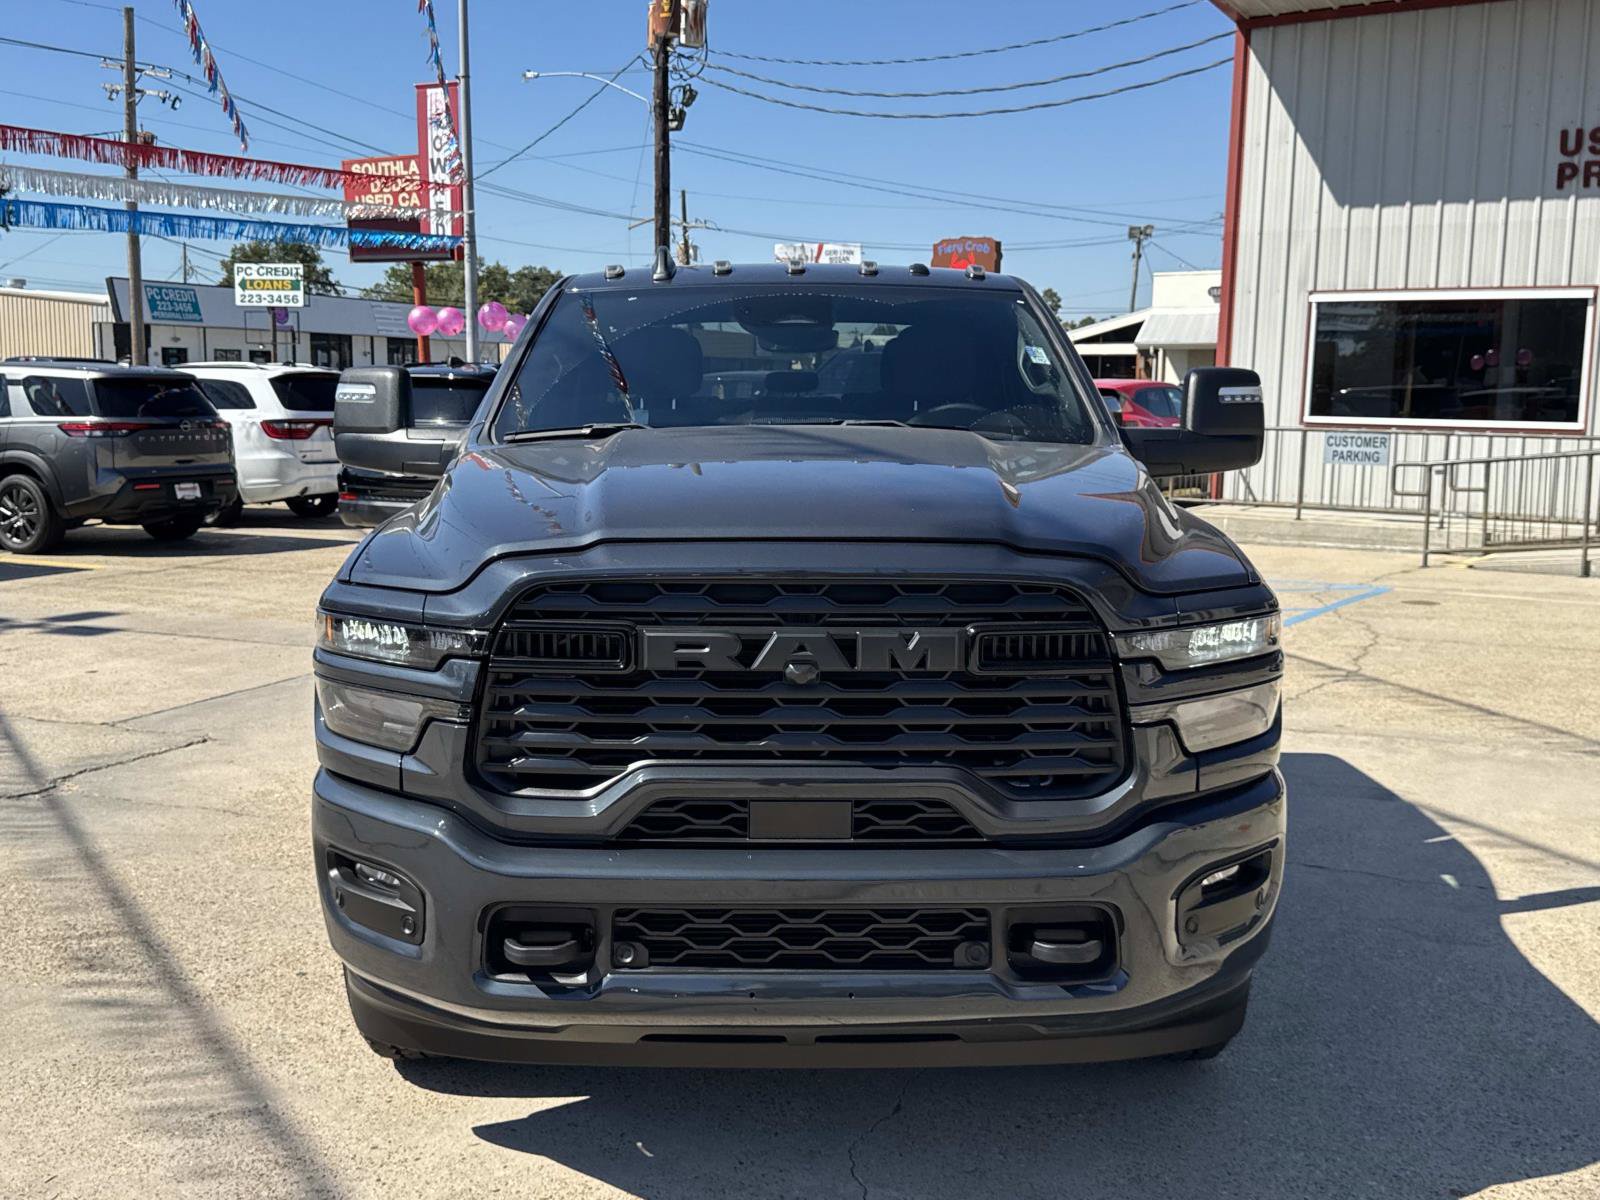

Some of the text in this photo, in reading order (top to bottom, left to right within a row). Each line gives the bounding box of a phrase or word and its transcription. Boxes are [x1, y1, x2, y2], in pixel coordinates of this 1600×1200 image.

[1556, 161, 1600, 190] PR
[236, 266, 301, 276] PC CREDIT
[246, 280, 292, 290] LOANS
[146, 288, 196, 303] PC CREDIT
[240, 294, 299, 304] 223-3456
[1326, 435, 1388, 449] CUSTOMER
[1332, 450, 1380, 463] PARKING
[643, 631, 958, 671] RAM
